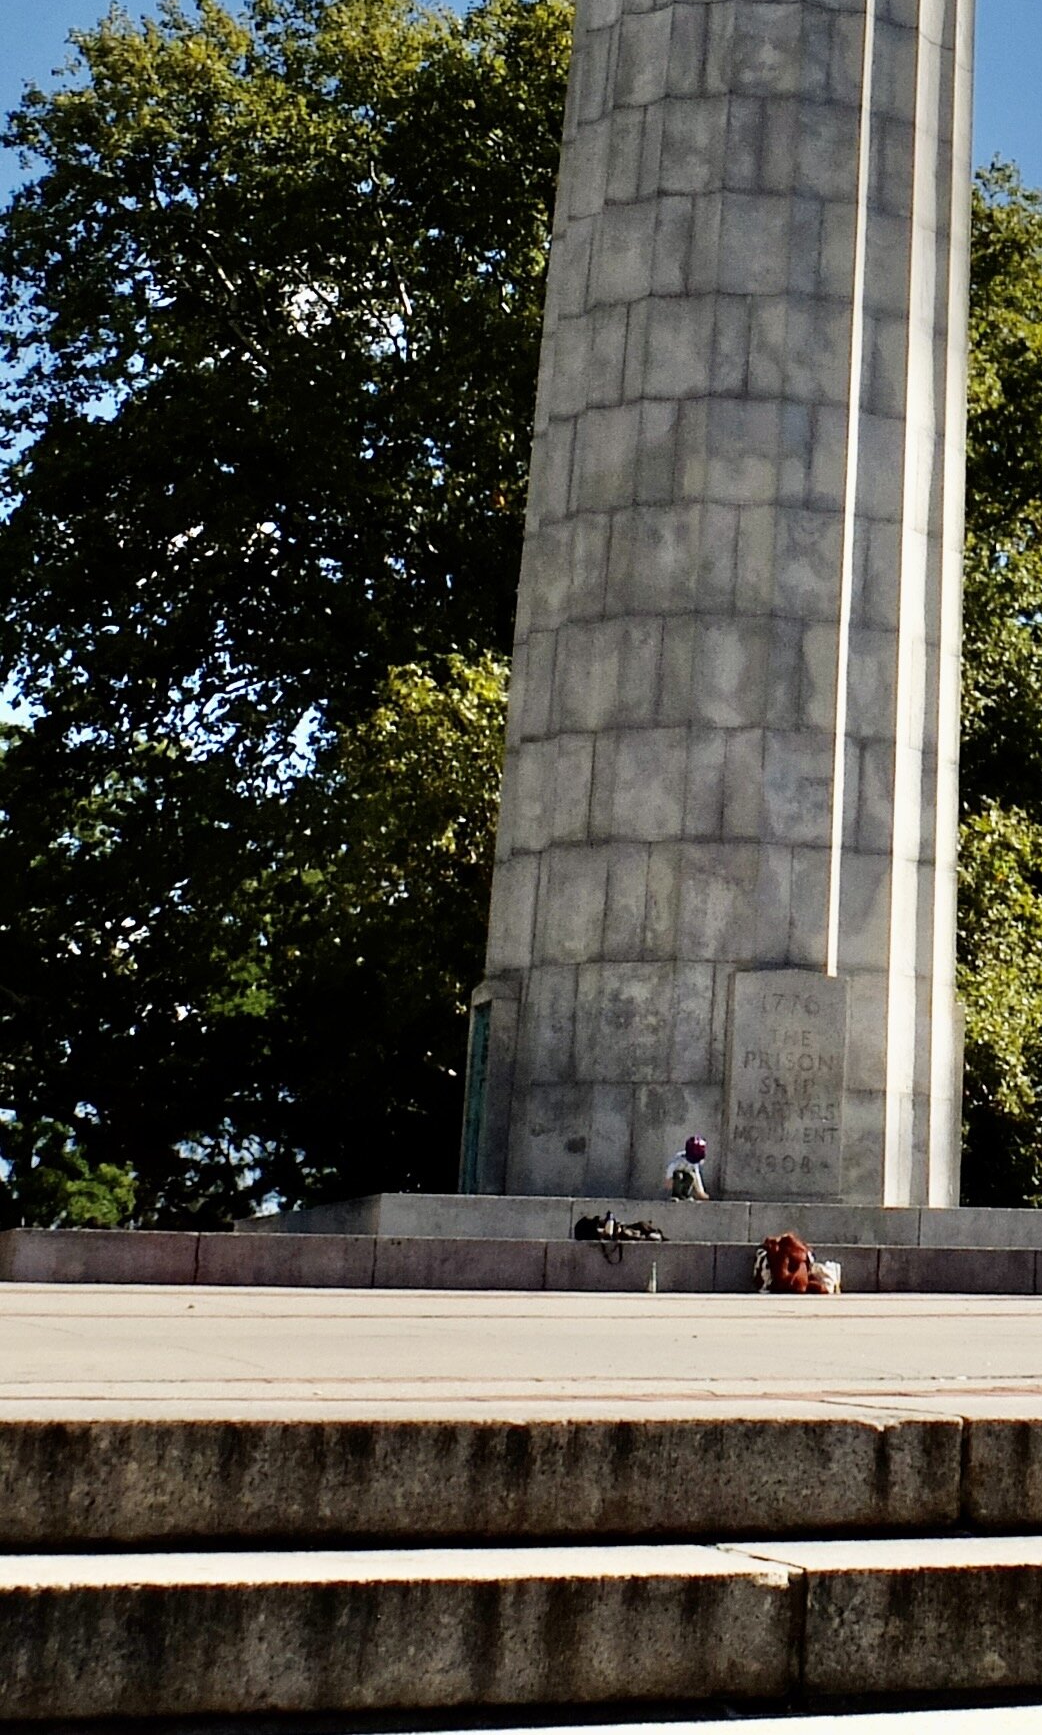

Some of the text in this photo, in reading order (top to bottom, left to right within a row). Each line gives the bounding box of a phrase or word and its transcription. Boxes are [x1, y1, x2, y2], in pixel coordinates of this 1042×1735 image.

[768, 1028, 812, 1046] THE
[743, 1049, 834, 1072] PRISON
[759, 1075, 815, 1096] SHIP
